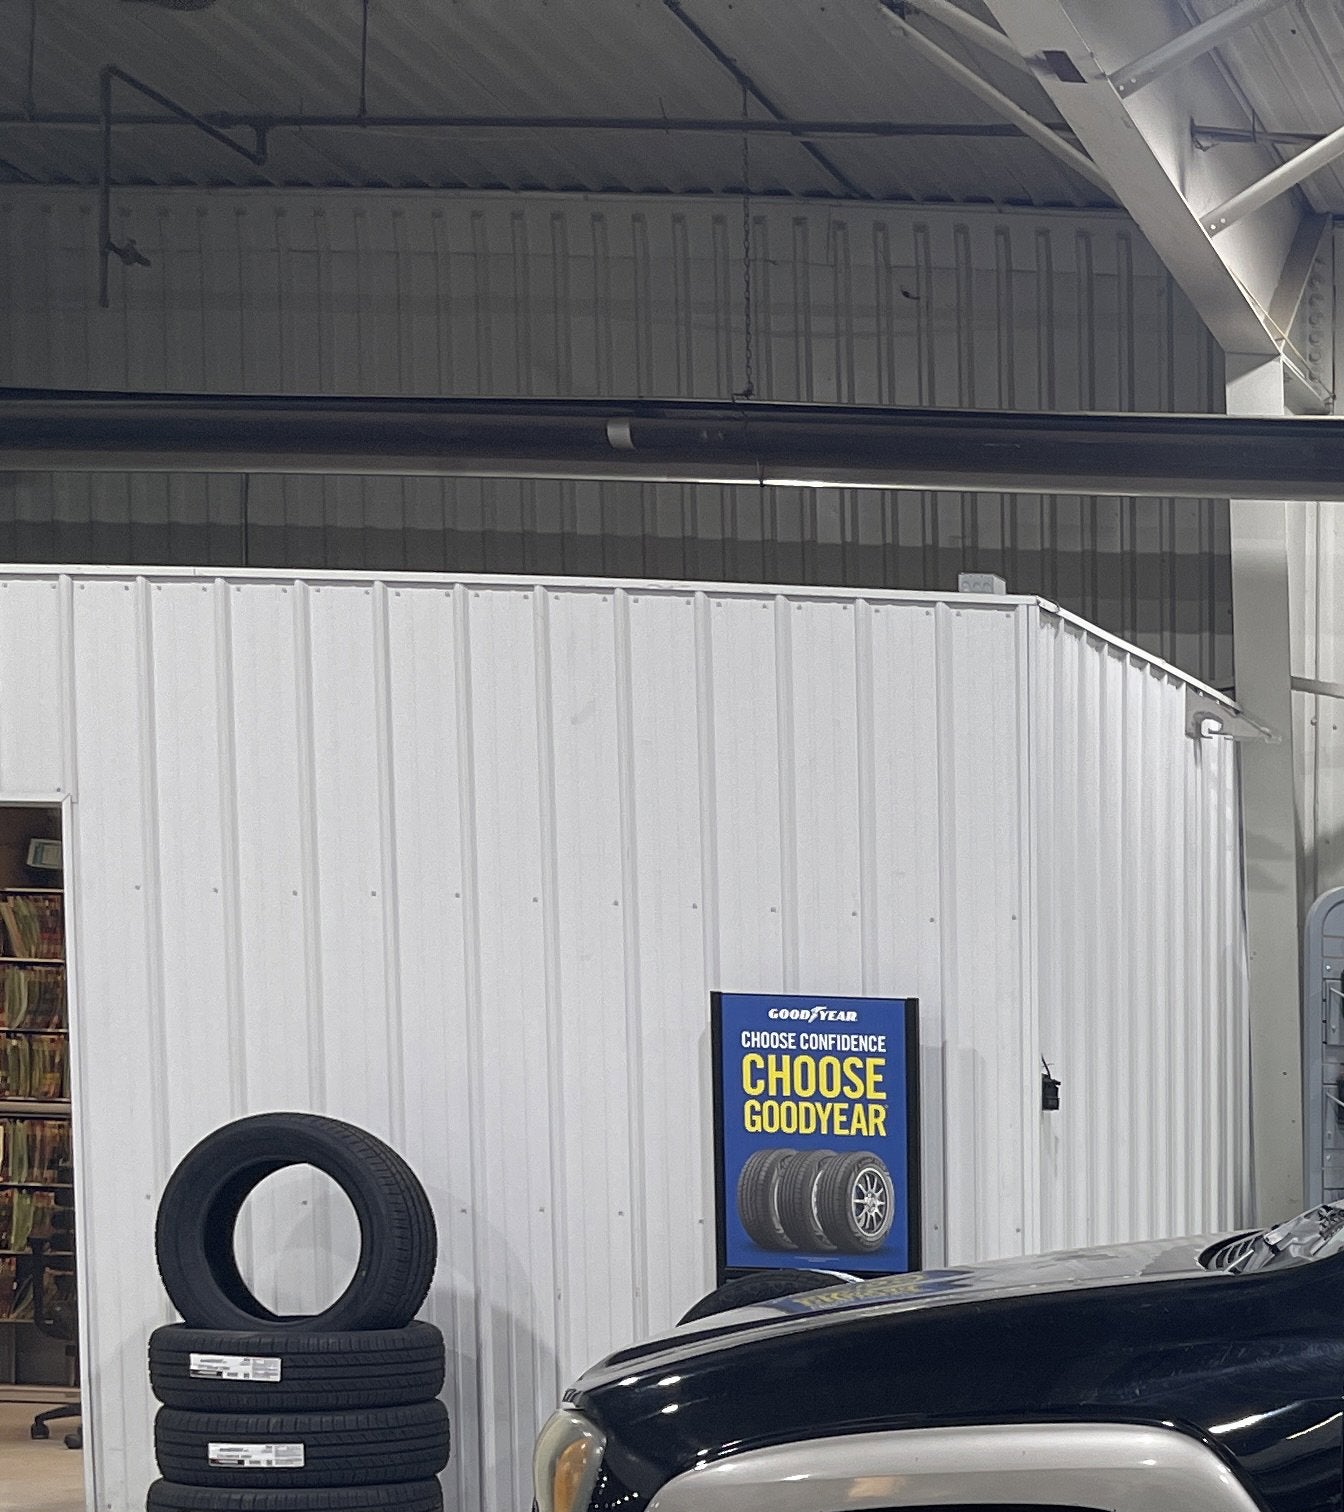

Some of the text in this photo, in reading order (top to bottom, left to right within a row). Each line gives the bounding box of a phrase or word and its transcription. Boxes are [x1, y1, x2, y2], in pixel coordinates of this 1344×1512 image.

[768, 1006, 858, 1023] GOODYEAR
[741, 1031, 887, 1053] CHOOSE CONFIDENCE
[742, 1053, 887, 1101] CHOOSE
[743, 1100, 888, 1137] GOODYEAR
